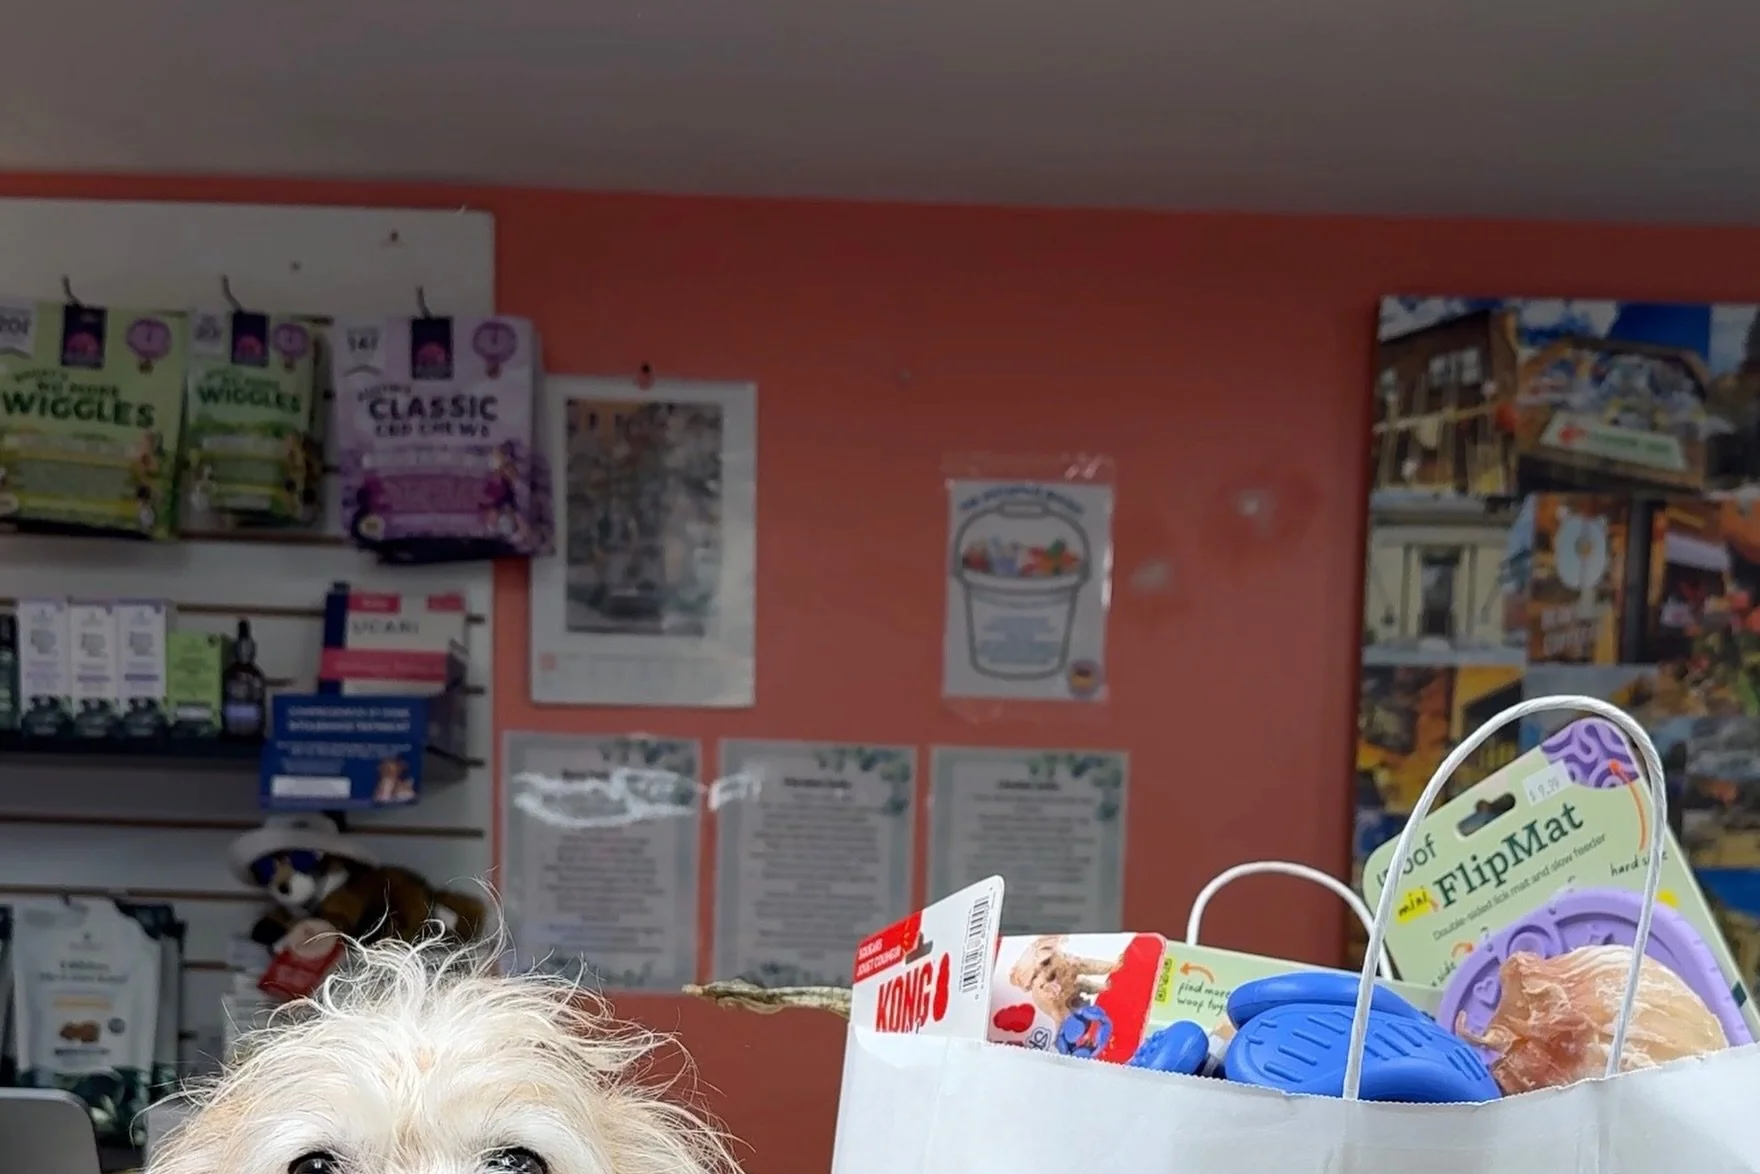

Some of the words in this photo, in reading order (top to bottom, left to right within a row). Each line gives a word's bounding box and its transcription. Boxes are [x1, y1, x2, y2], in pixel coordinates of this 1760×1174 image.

[2, 389, 156, 428] WIGGLES
[369, 393, 499, 422] CLASSIC
[1376, 832, 1437, 889] oof
[1432, 802, 1584, 909] FlipMat
[1610, 854, 1640, 877] hard
[1432, 898, 1493, 942] Double-sided
[1510, 877, 1530, 896] mat
[1531, 868, 1551, 884] and
[1549, 852, 1574, 872] slow
[1572, 832, 1607, 858] feeder
[875, 961, 934, 1034] KONG
